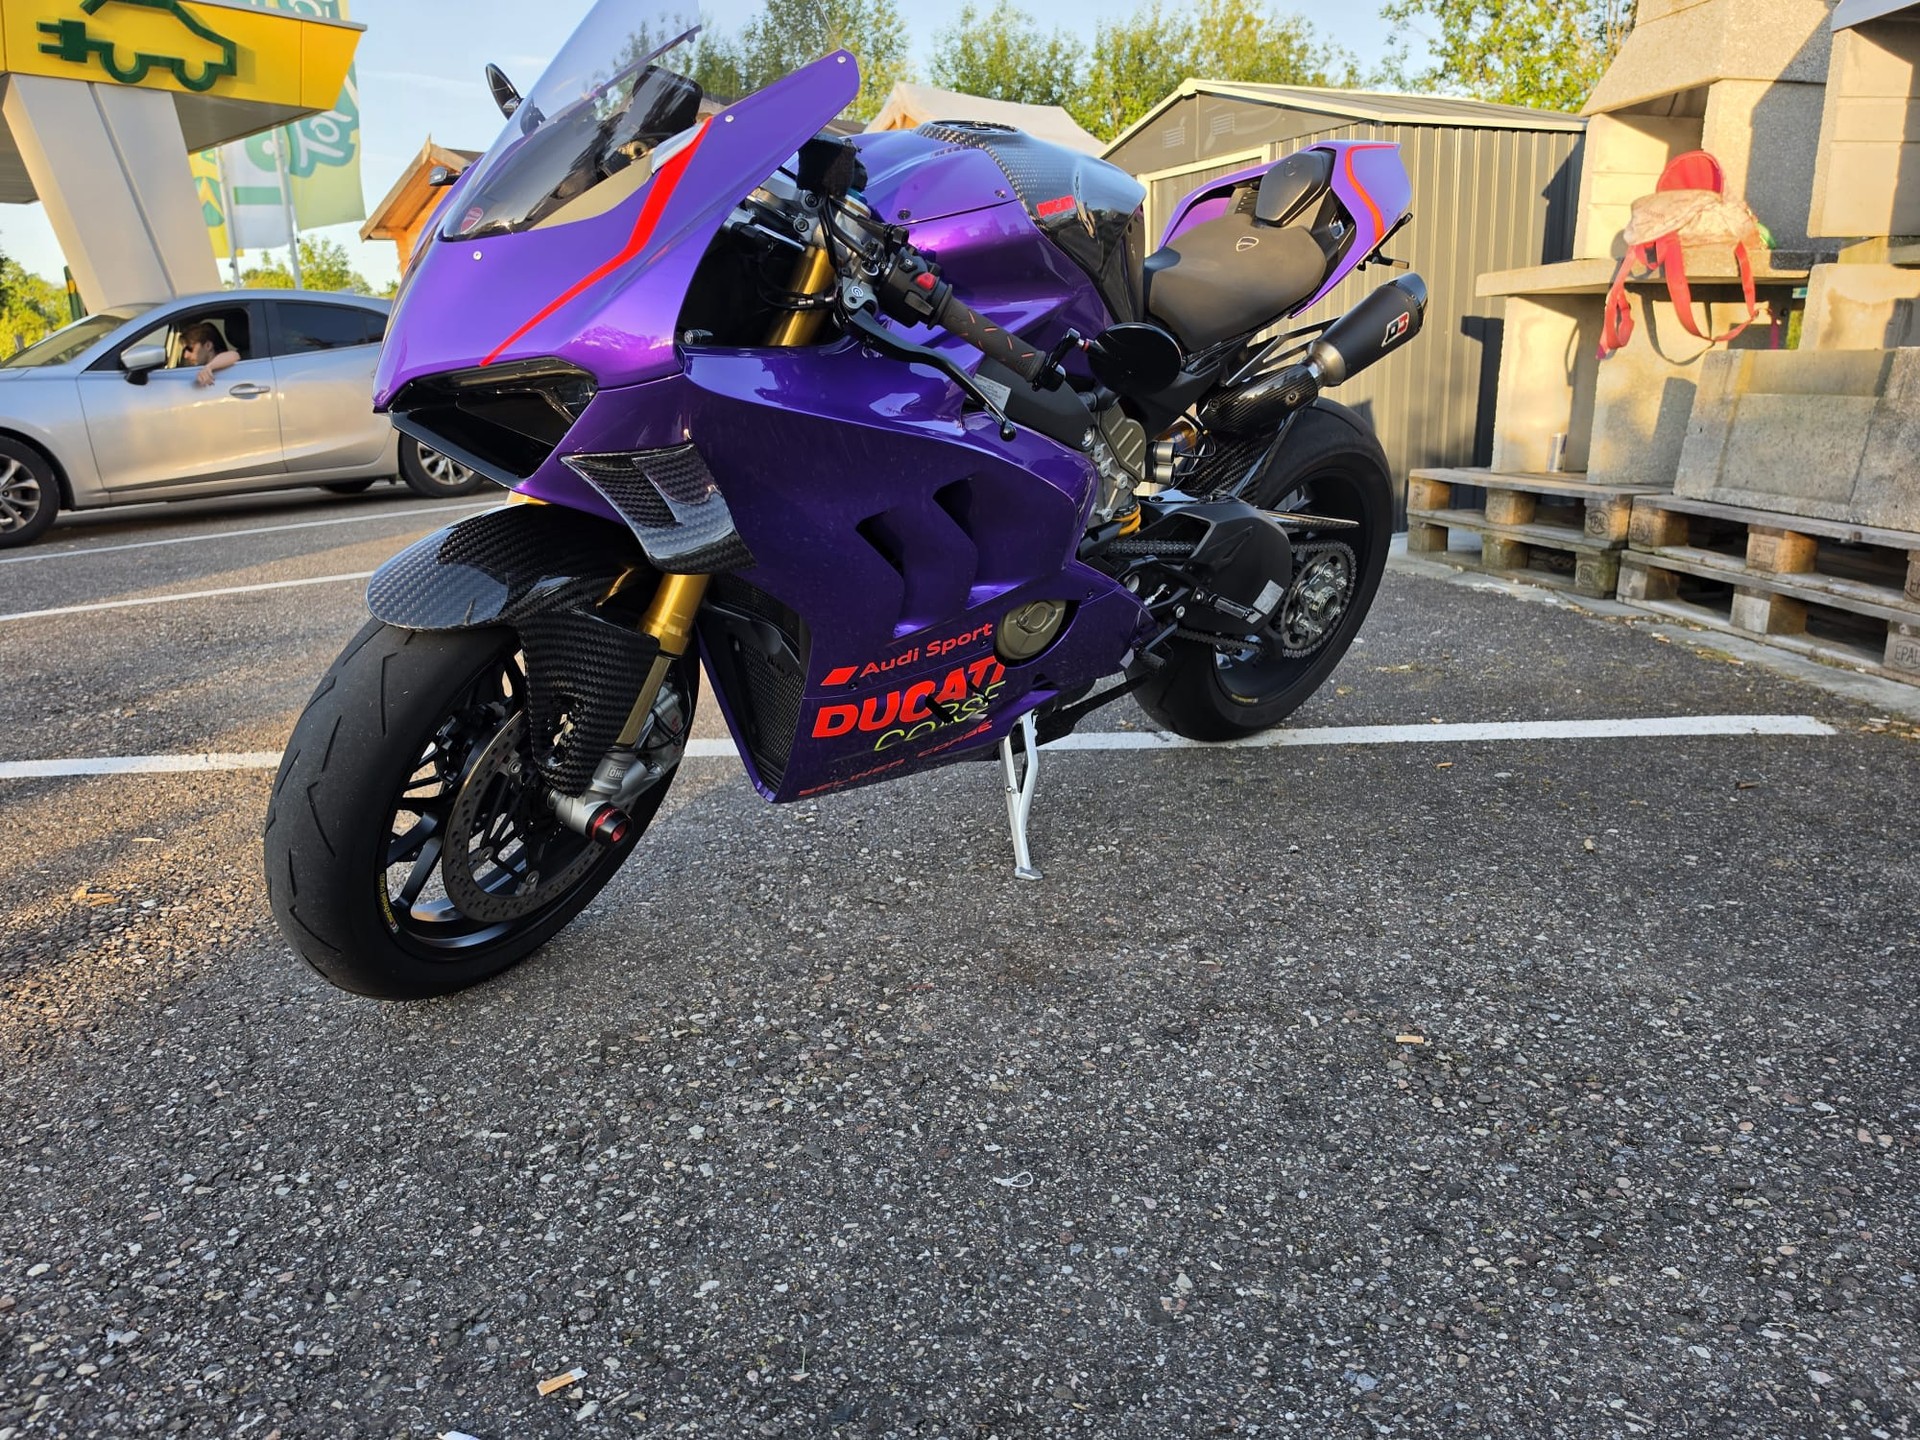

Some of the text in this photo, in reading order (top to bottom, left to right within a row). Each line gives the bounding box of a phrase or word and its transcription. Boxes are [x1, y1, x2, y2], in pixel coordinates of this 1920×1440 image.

[860, 623, 994, 678] Audi Sport
[811, 655, 1006, 738] DUCATI
